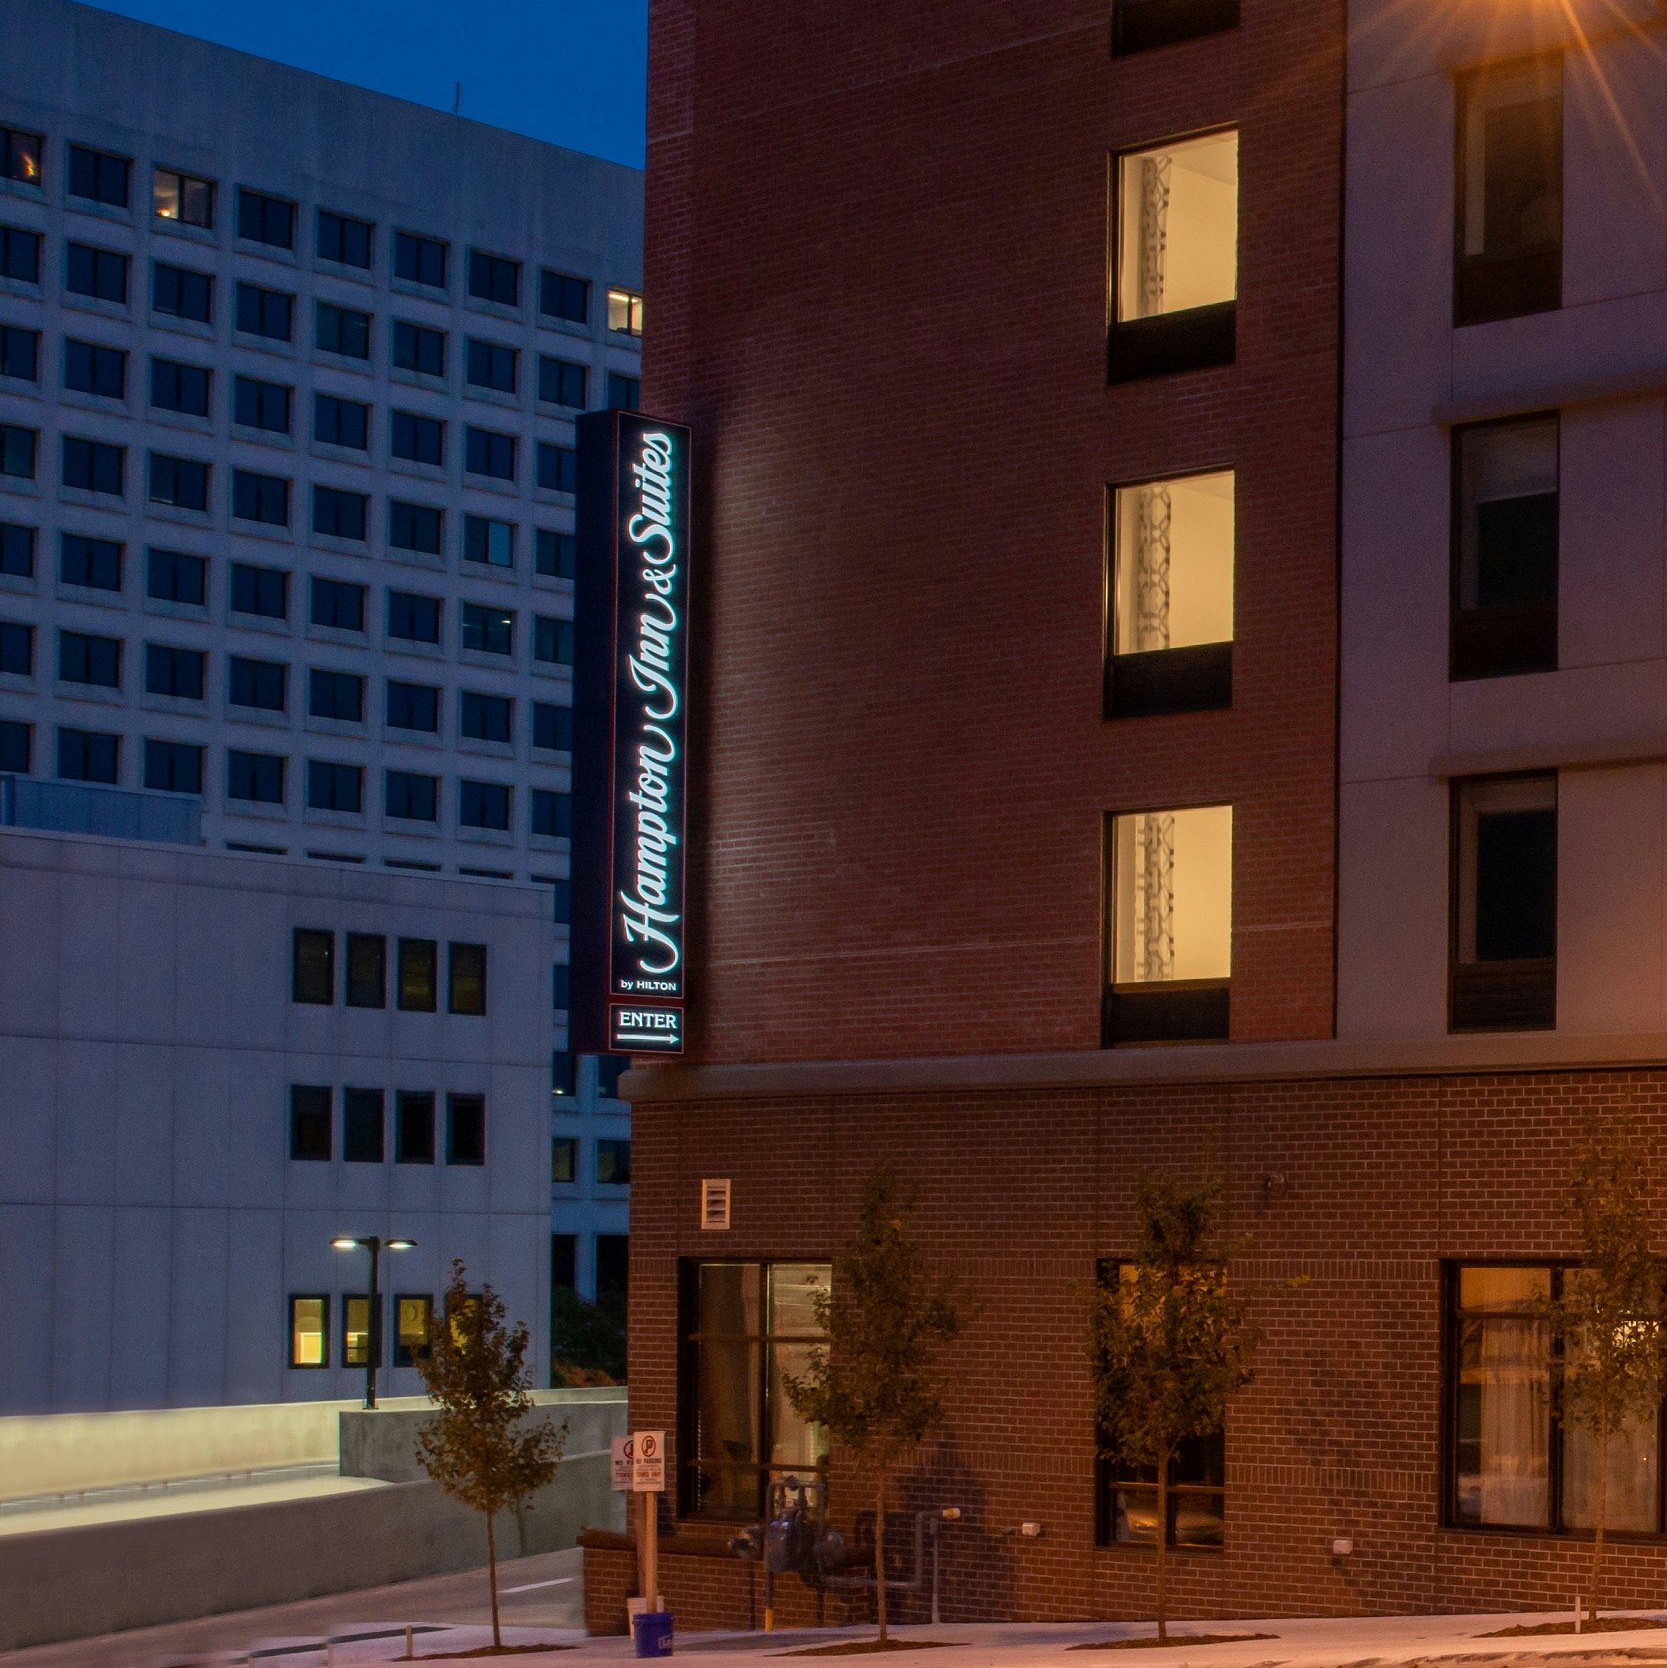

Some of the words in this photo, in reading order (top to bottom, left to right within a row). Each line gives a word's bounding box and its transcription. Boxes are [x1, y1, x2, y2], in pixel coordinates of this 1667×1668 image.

[628, 432, 674, 565] Suites
[643, 563, 676, 595] &
[629, 593, 677, 720] Inn
[620, 724, 680, 974] Hampton
[619, 1011, 678, 1029] ENTER
[621, 979, 634, 990] by
[636, 980, 677, 991] HILTON
